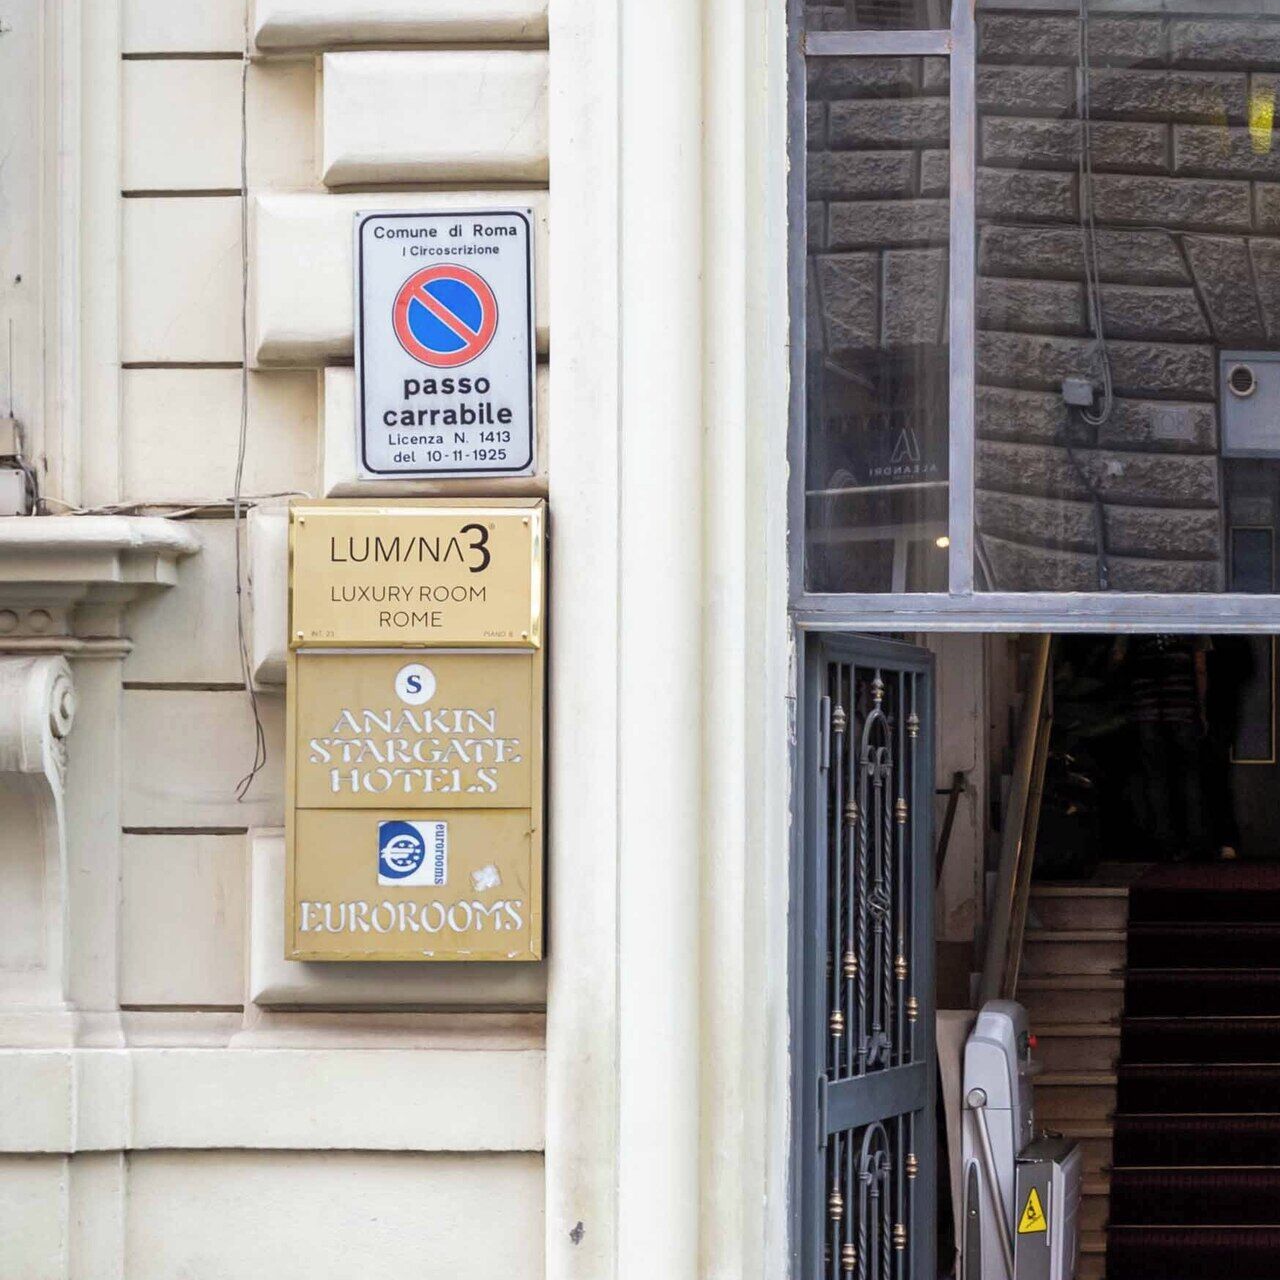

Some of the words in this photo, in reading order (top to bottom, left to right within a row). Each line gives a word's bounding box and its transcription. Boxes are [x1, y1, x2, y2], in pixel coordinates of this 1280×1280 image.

[374, 226, 437, 239] Comune
[449, 224, 462, 237] di
[473, 224, 517, 237] Roma
[410, 245, 500, 256] Circoscrizione
[404, 376, 490, 400] passo
[383, 403, 513, 427] carrabile
[388, 434, 443, 446] Licenza
[454, 432, 469, 444] N.
[480, 431, 511, 444] 1413
[393, 451, 416, 463] del
[331, 586, 414, 602] LUXURY
[419, 586, 487, 602] ROOM
[380, 611, 443, 627] ROME
[406, 675, 422, 694] S
[332, 708, 496, 734] ANAKIN
[309, 738, 523, 764] STARGATE
[329, 768, 499, 793] HOTELS
[434, 824, 445, 885] eurorooms
[299, 900, 523, 933] EUROROOMS
